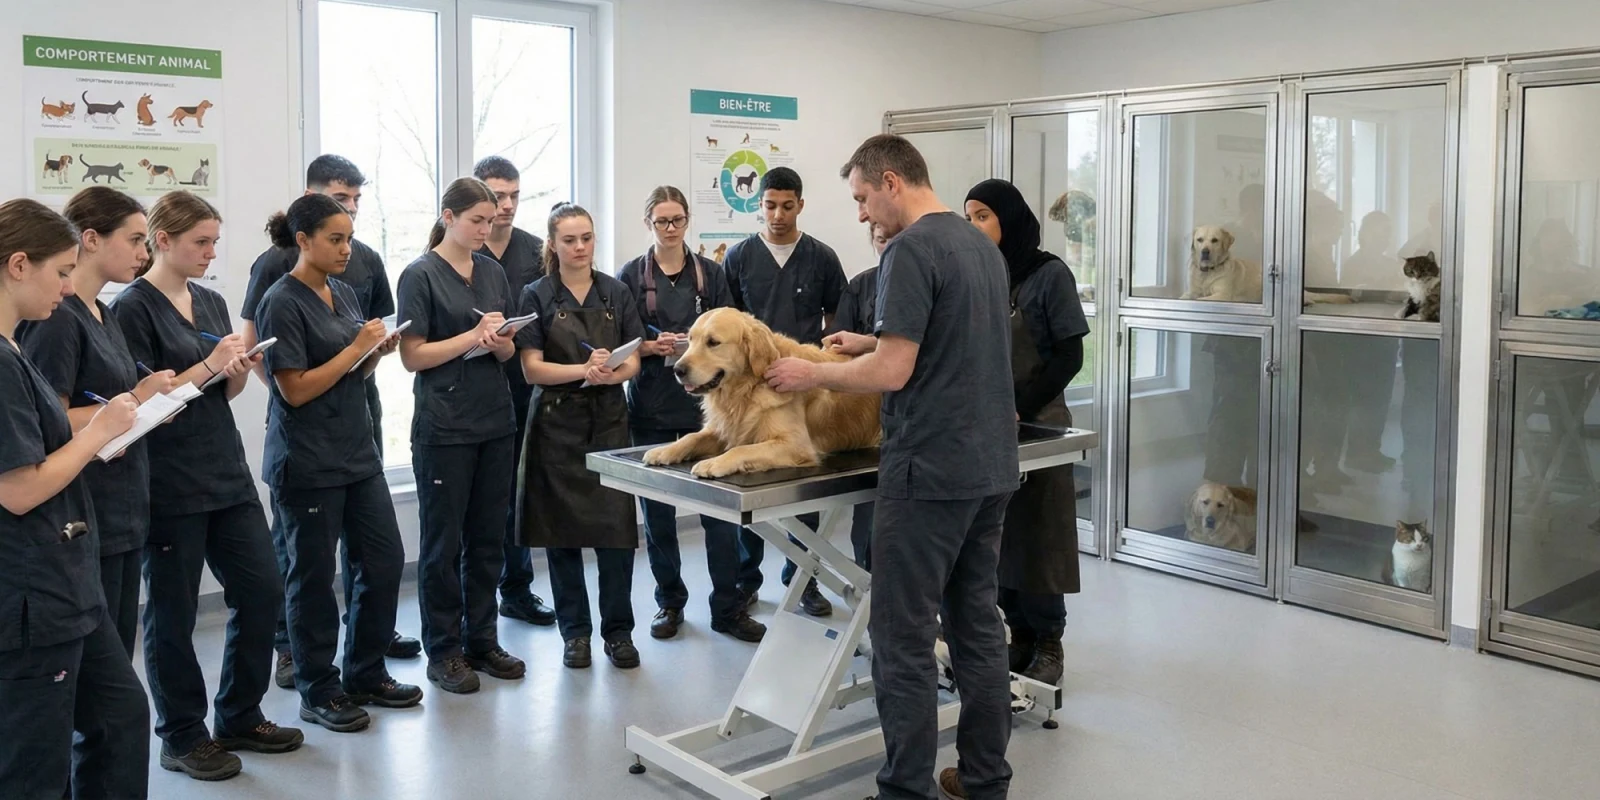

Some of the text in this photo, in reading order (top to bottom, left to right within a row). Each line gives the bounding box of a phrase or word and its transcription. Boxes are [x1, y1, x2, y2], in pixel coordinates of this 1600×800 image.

[35, 46, 211, 70] COMPORTEMENT ANIMAL
[719, 98, 771, 112] BIEN-ÊTRE
